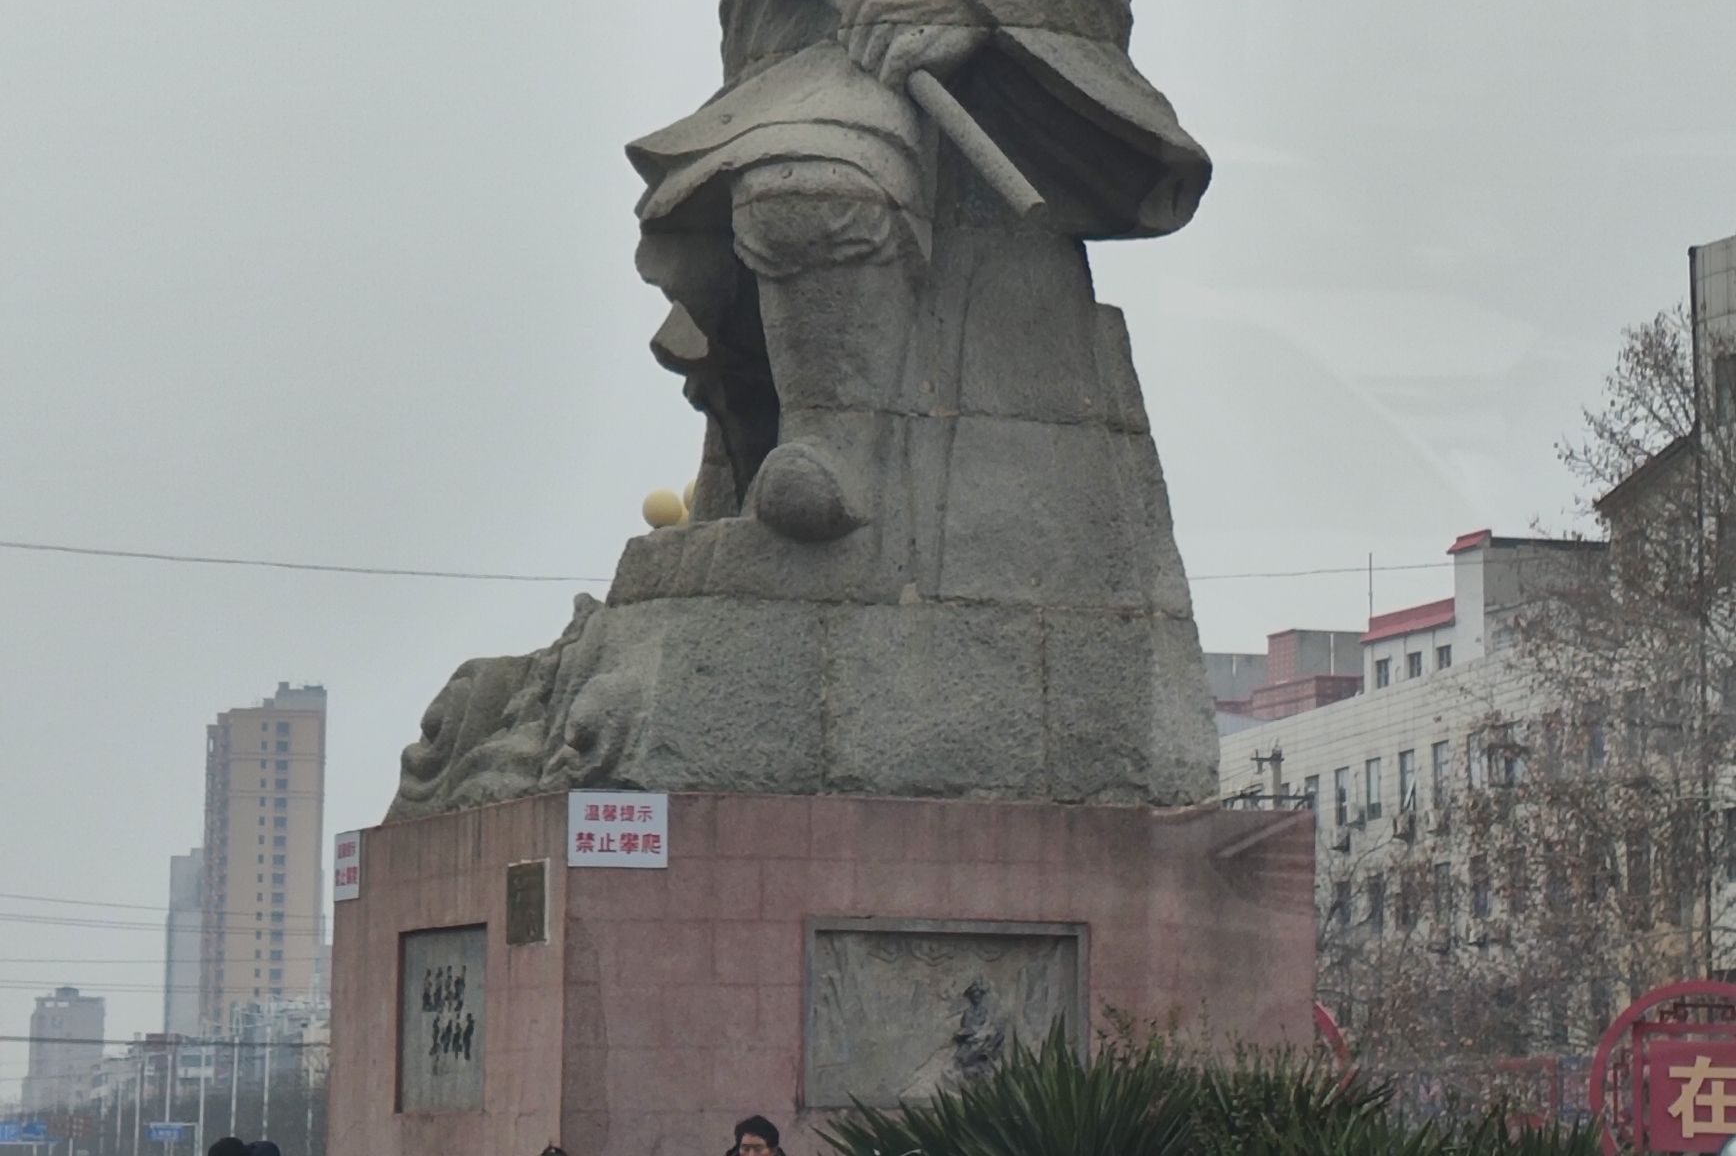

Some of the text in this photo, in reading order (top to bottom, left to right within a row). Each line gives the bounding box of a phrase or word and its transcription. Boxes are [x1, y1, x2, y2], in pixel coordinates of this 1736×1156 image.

[584, 804, 653, 823] 温馨提示
[576, 832, 662, 855] 禁止攀爬
[1667, 1055, 1736, 1139] 在
